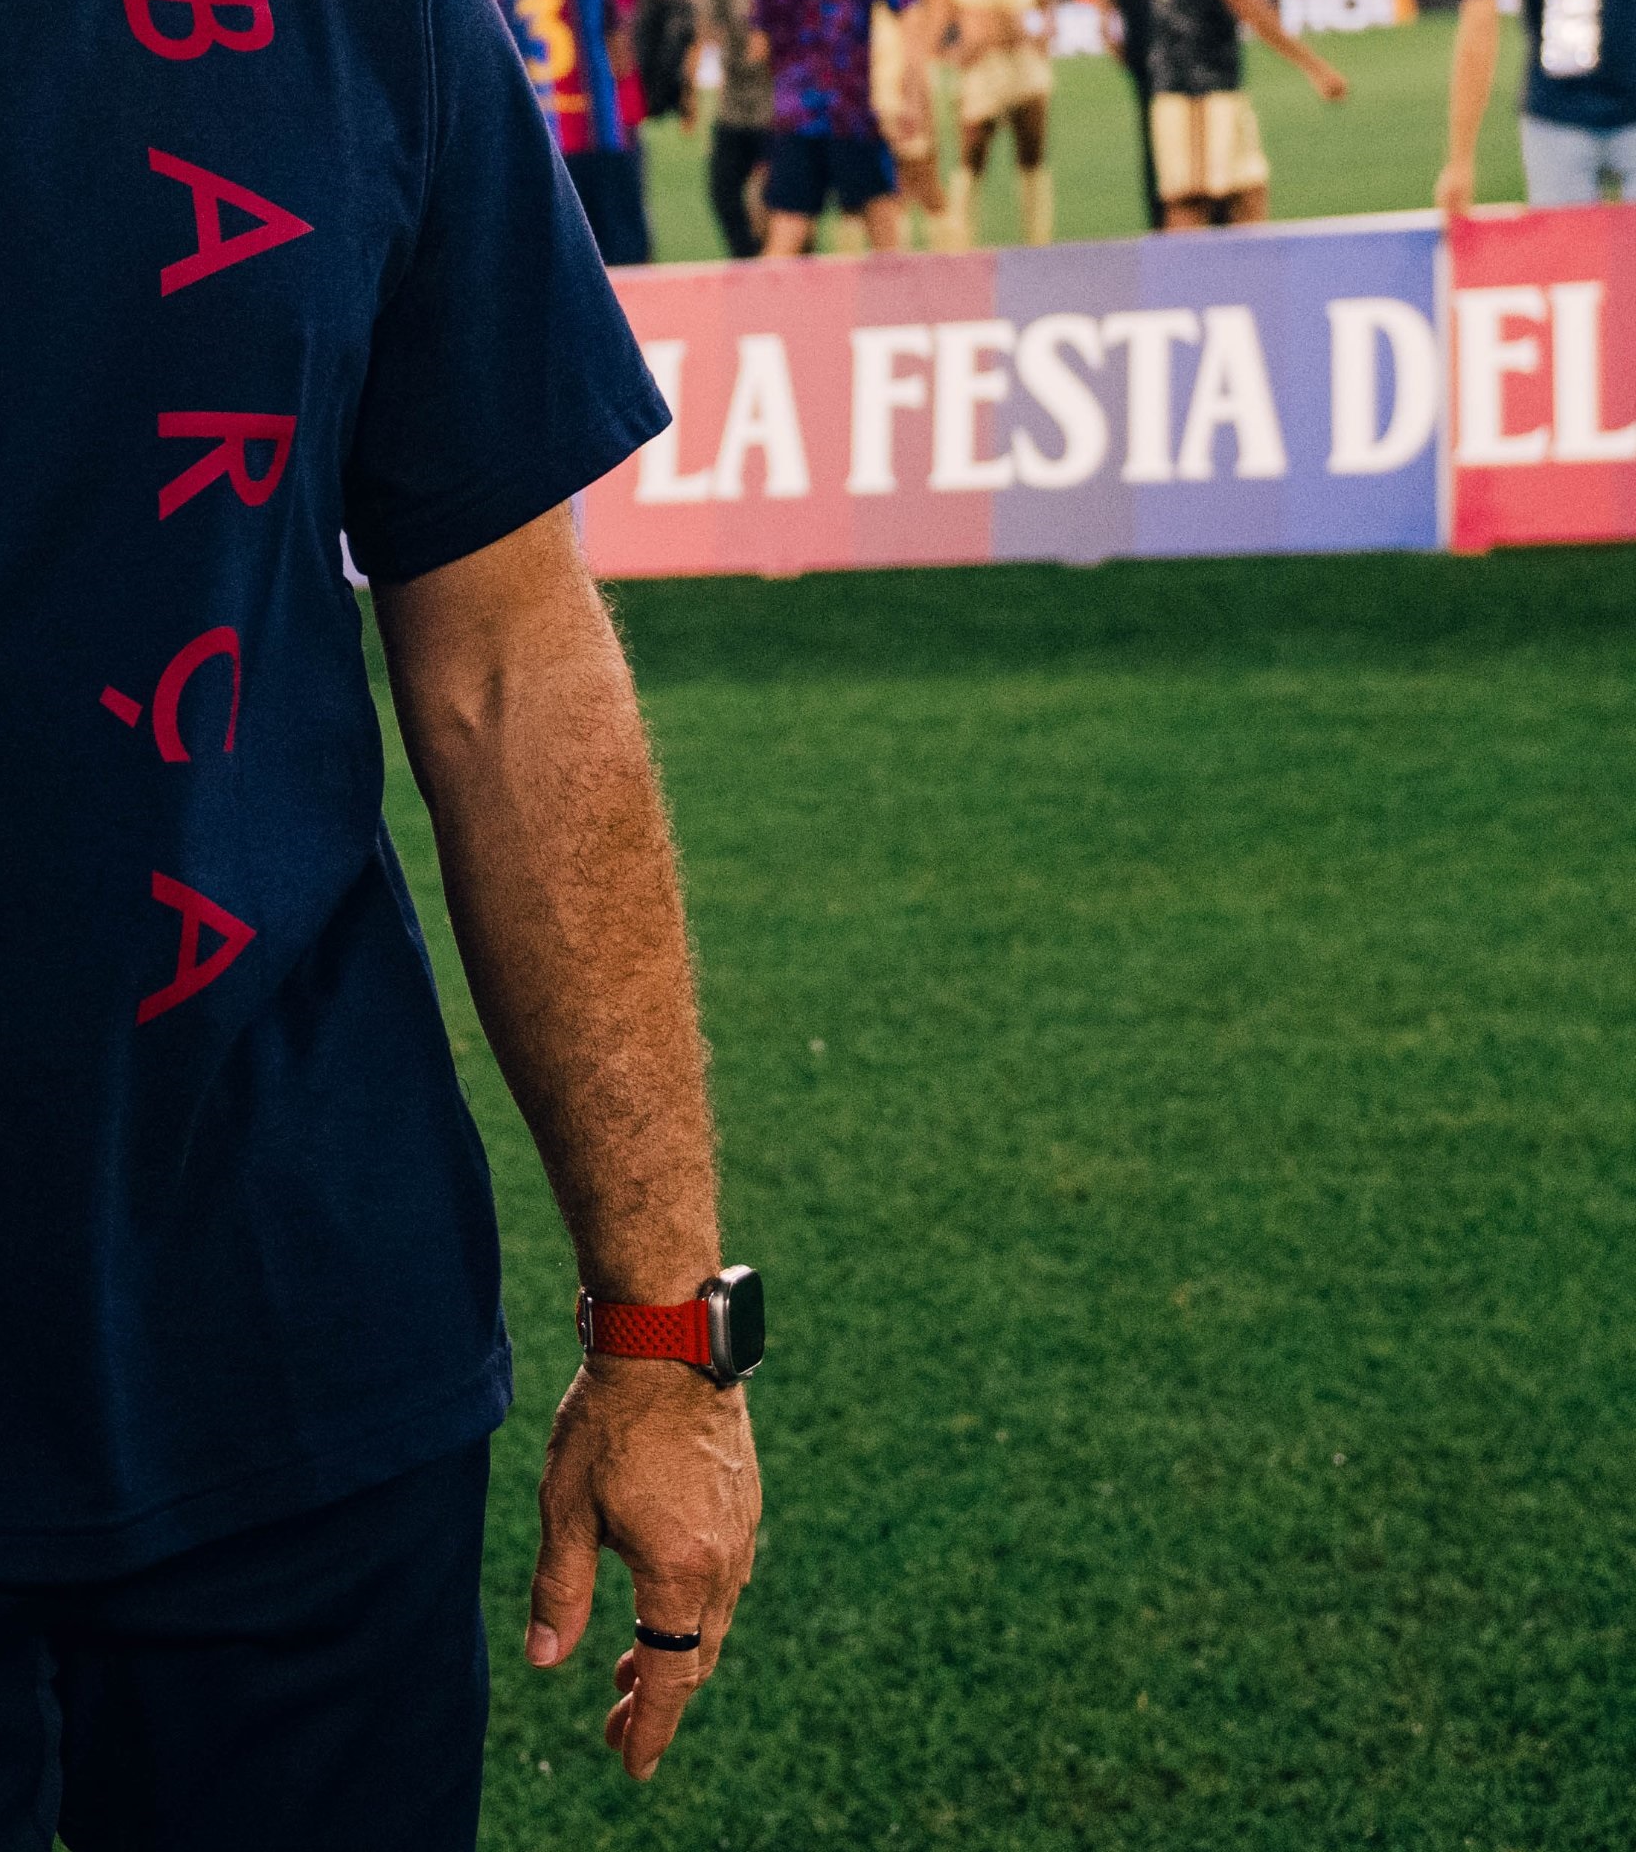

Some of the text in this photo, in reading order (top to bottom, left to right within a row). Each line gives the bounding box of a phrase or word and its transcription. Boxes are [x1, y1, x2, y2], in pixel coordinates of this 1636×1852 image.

[635, 279, 1636, 505] LA FESTA DEL
